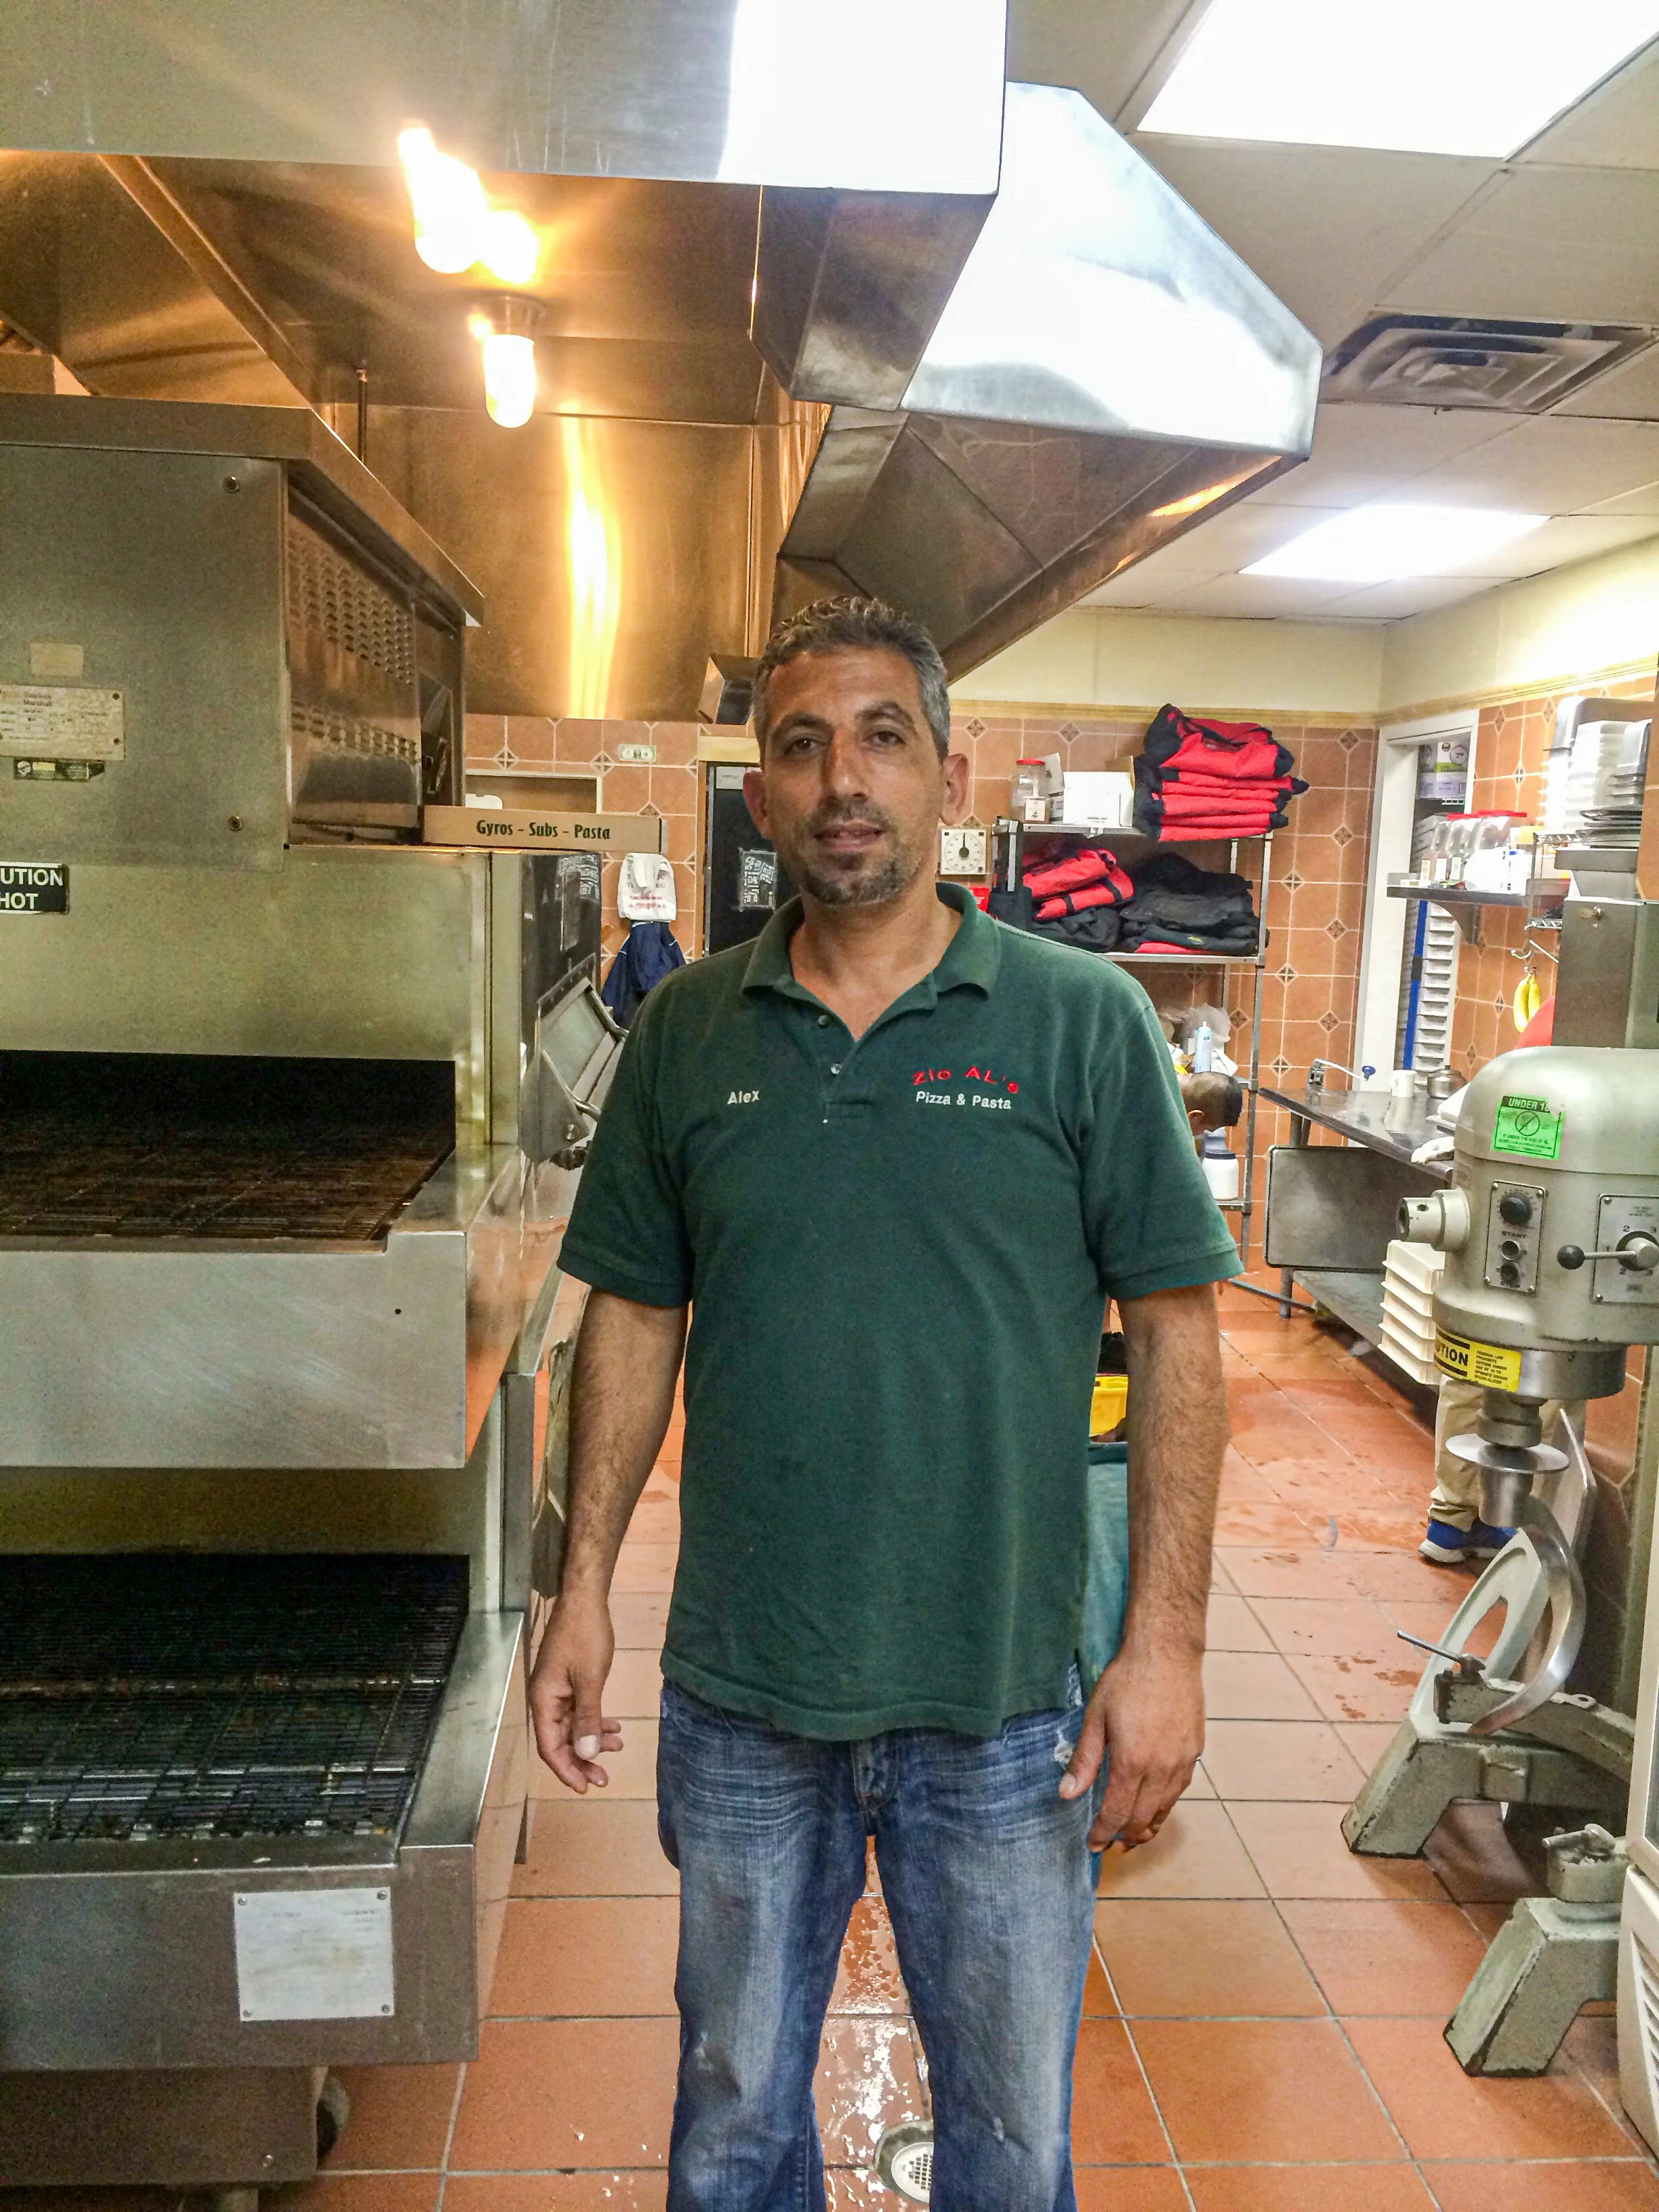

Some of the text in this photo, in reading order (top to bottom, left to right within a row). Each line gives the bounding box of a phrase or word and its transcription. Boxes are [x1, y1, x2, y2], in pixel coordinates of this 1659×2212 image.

[476, 819, 513, 836] Gyros
[529, 822, 558, 837] Subs
[574, 824, 611, 840] Pasta
[0, 868, 63, 886] UTION
[0, 892, 39, 909] HOT
[916, 1090, 1011, 1109] Pizza & Pasta
[1509, 1097, 1538, 1110] UNDER
[1502, 1231, 1527, 1239] START
